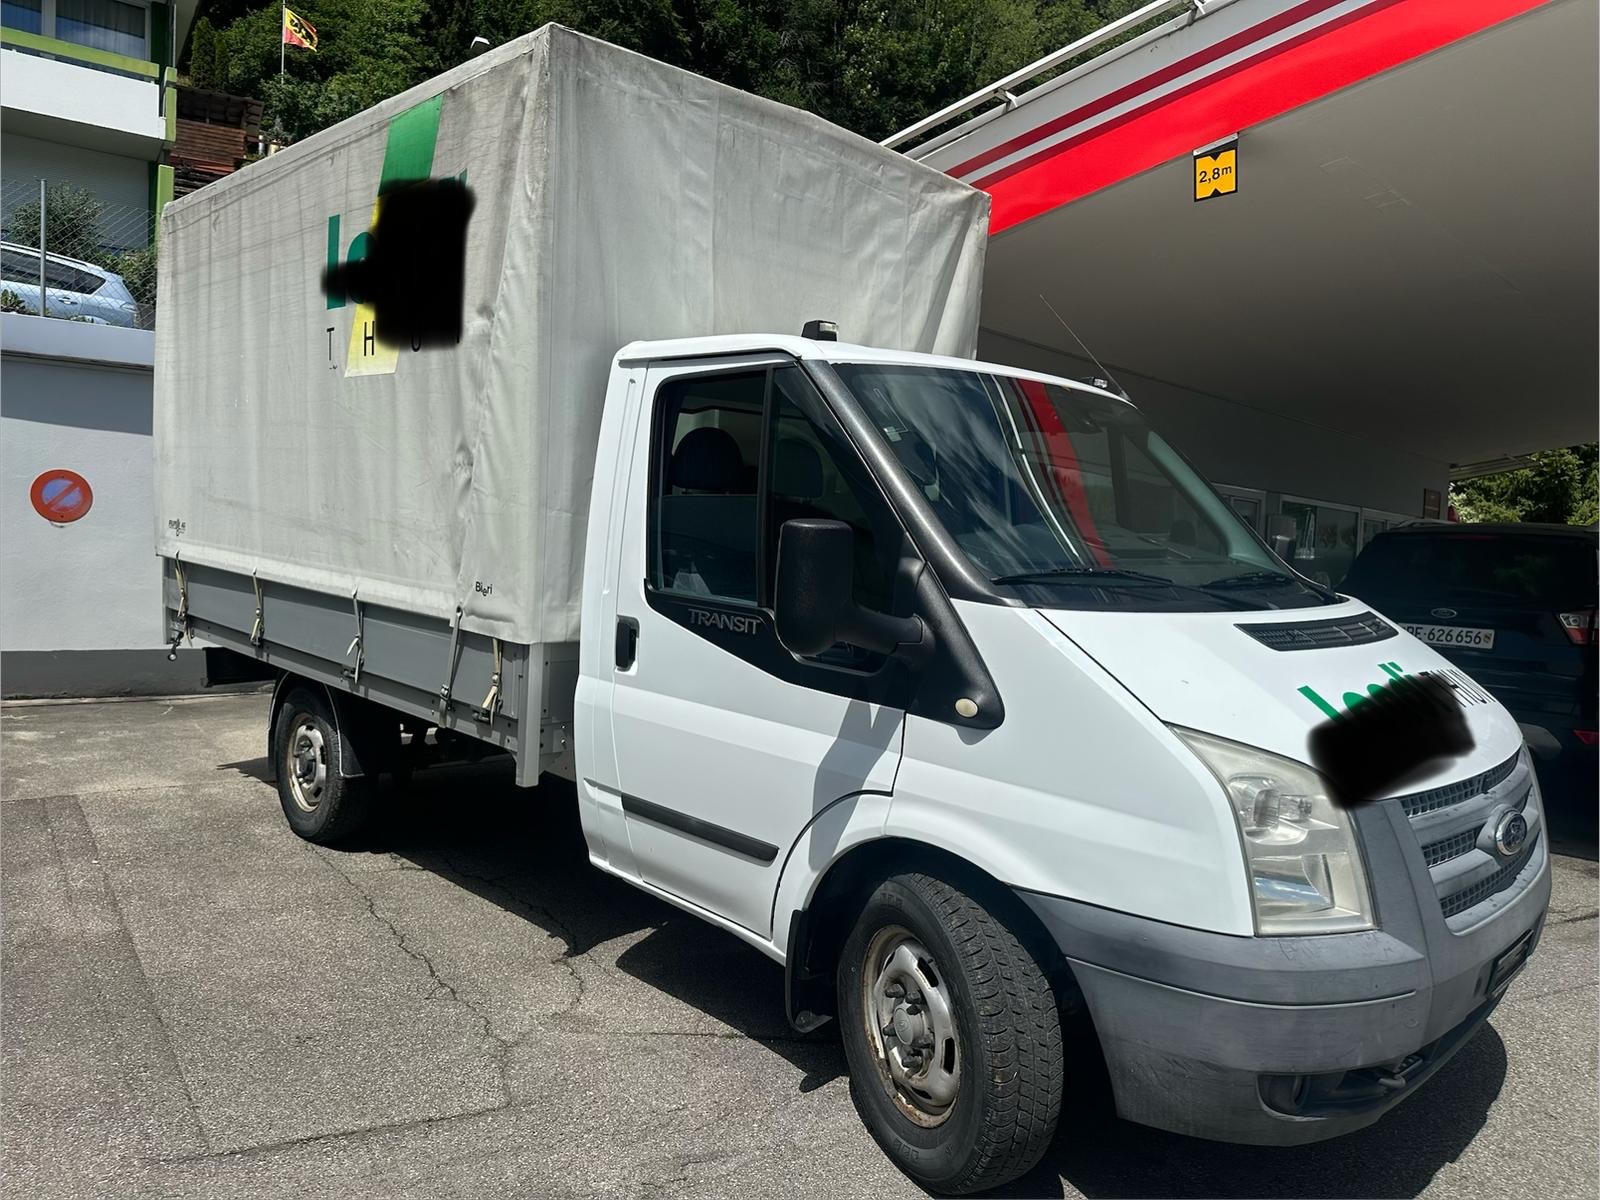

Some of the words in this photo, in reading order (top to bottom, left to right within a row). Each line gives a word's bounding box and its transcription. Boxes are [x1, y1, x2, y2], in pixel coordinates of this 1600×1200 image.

[1199, 166, 1232, 184] 2,8m
[475, 581, 493, 597] Bieri
[688, 608, 761, 635] TRANSIT
